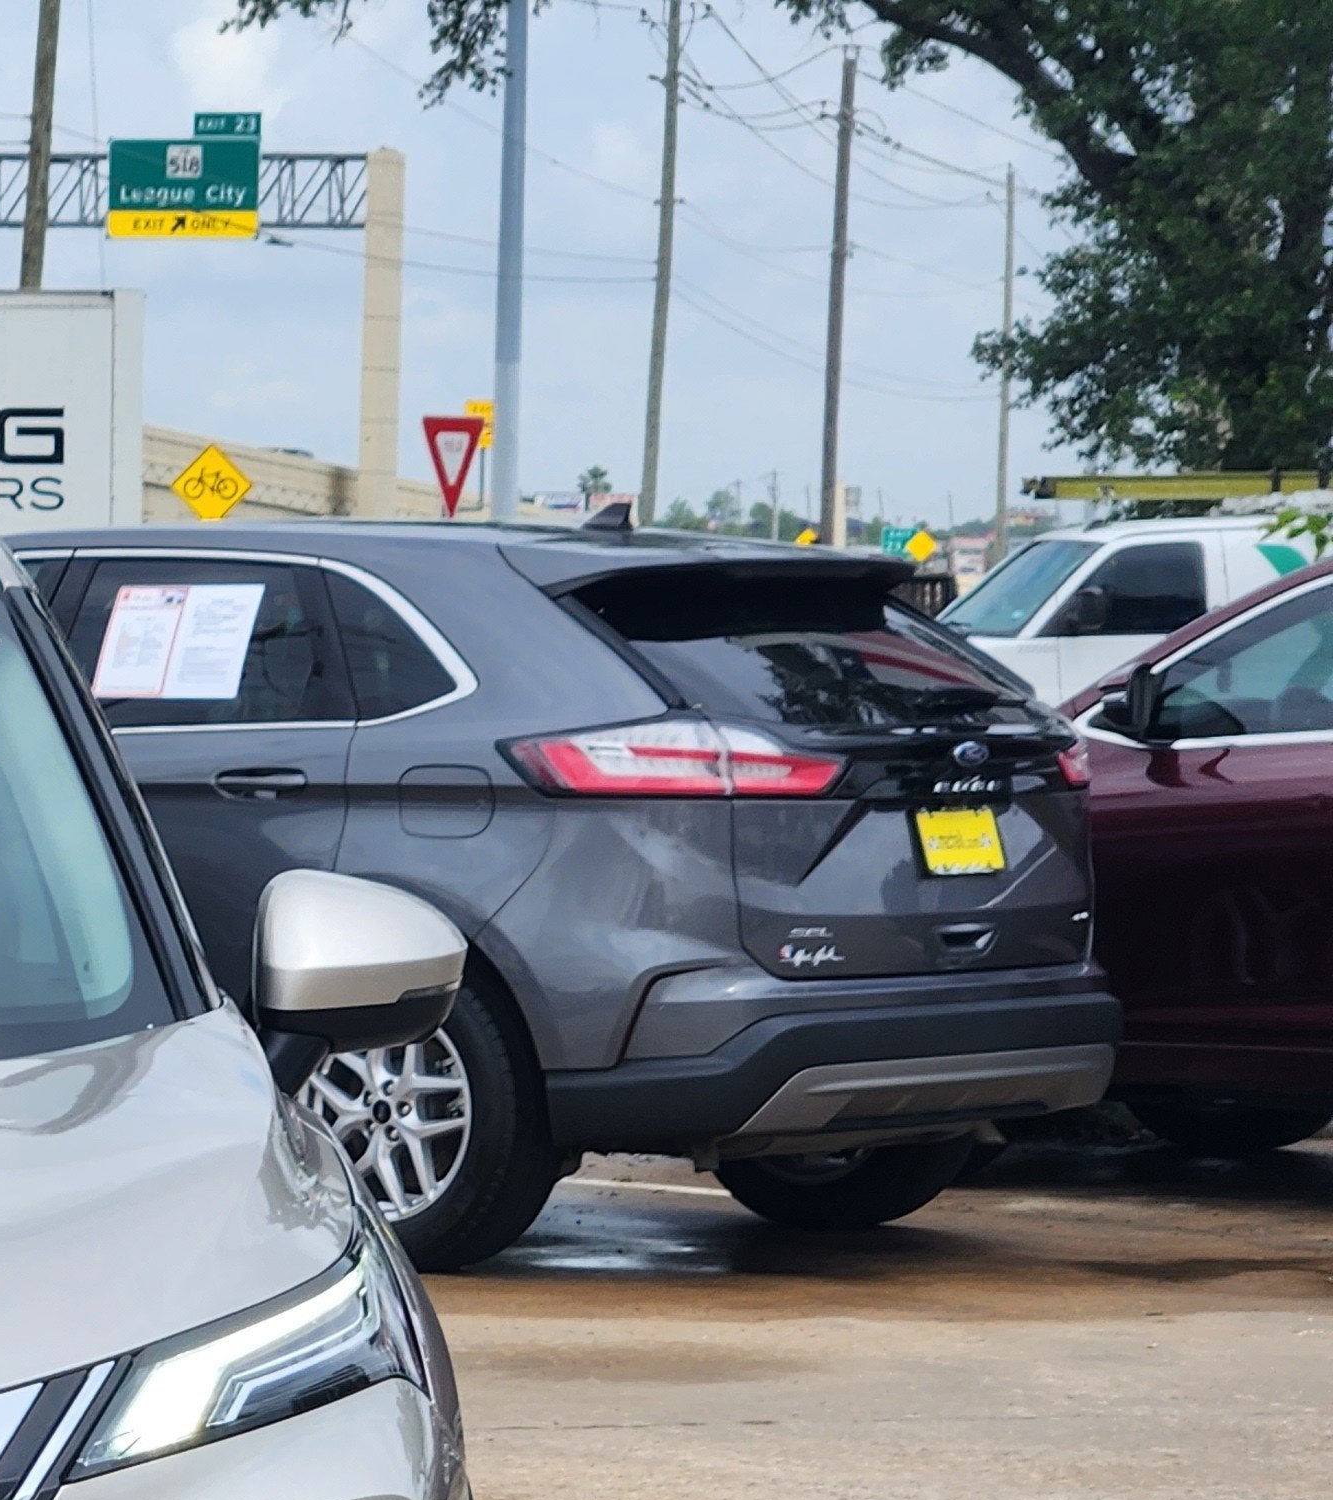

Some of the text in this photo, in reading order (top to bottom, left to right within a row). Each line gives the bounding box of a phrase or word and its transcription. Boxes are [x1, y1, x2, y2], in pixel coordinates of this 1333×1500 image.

[198, 116, 257, 133] EXIT 23
[169, 156, 200, 174] 518
[119, 183, 247, 207] League City
[133, 218, 164, 230] EXIT
